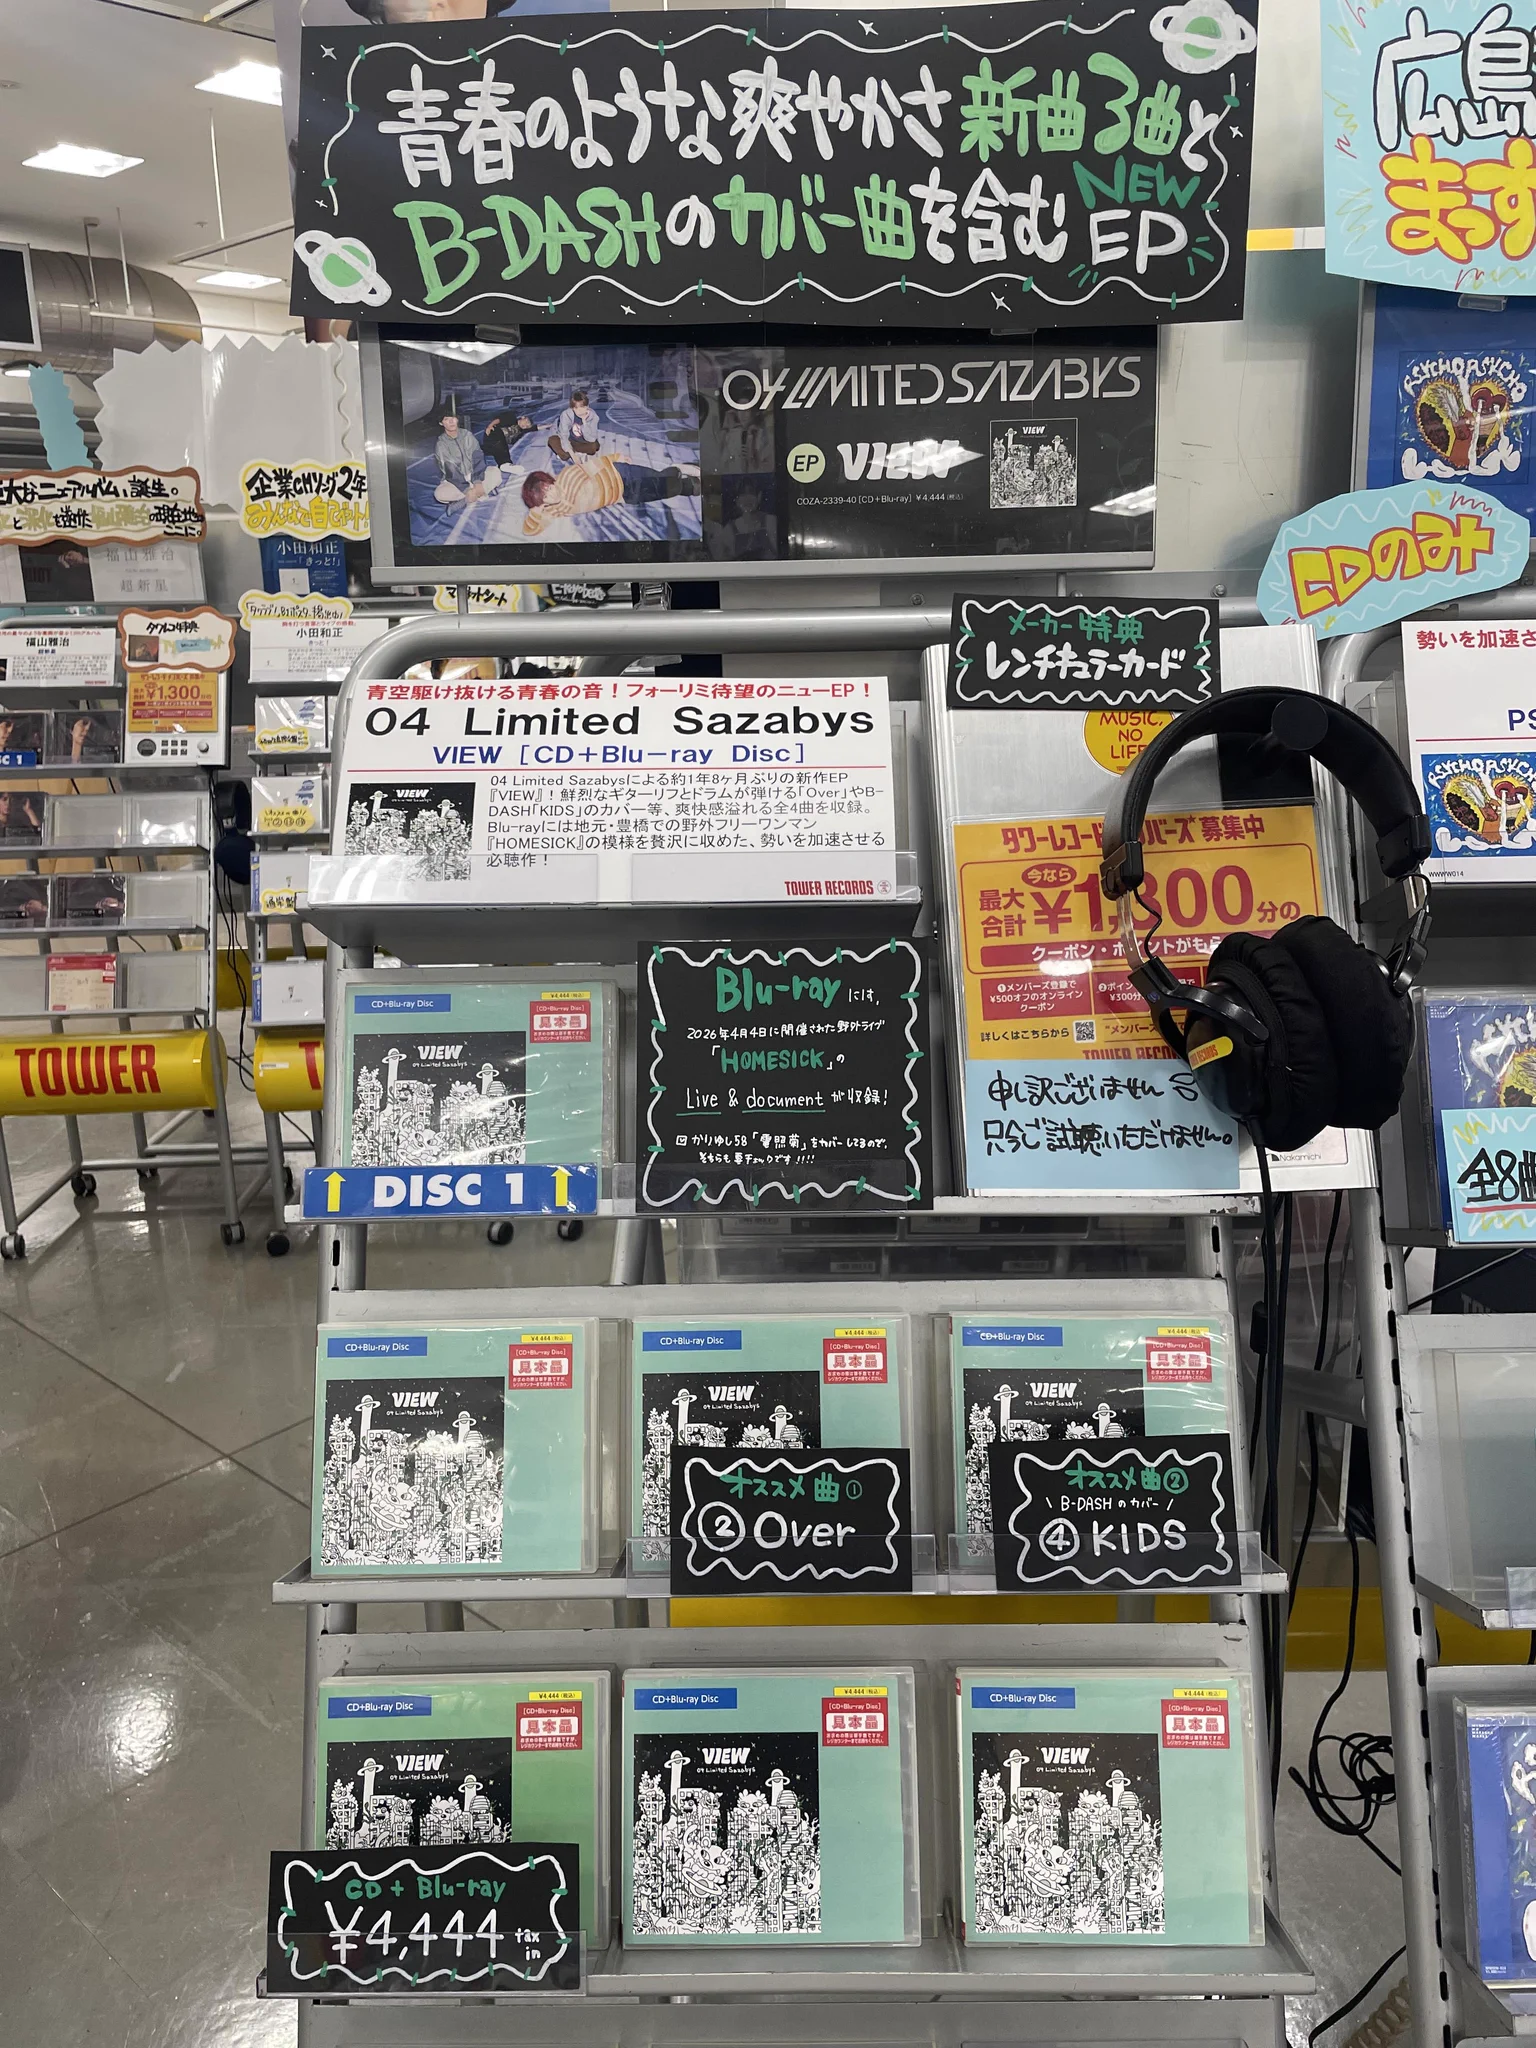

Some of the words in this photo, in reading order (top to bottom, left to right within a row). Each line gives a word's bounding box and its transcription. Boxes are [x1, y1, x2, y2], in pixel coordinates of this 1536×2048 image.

[1373, 3, 1536, 152] 広島
[378, 53, 1219, 187] 青春のような爽やかさ新曲3曲と
[1073, 156, 1200, 209] NEW
[393, 167, 1068, 303] B-DASHのカバー曲を含む
[1090, 210, 1188, 273] EP
[946, 356, 1141, 403] SAZABYS
[1022, 426, 1045, 435] VIEW
[793, 455, 819, 471] EP
[277, 541, 339, 555] 小田和正
[1288, 512, 1494, 618] CDのみ
[296, 627, 343, 638] 小田和正
[1008, 609, 1144, 645] メーカー特典
[986, 640, 1187, 681] レンチキュラーカード
[365, 707, 430, 736] 04
[464, 706, 640, 736] Limited
[673, 705, 874, 737] Sazabys
[1099, 711, 1163, 726] MUSIC,
[1118, 729, 1142, 742] NO
[433, 745, 502, 764] VIEW
[732, 743, 804, 763] Disc]
[491, 775, 507, 786] 04
[513, 775, 564, 786] Limited
[395, 788, 429, 798] VIEW
[1201, 814, 1265, 842] 募集中
[1027, 865, 1072, 883] 今なら
[785, 880, 822, 895] TOWER
[825, 880, 874, 895] RECORDS
[980, 888, 1025, 911] 最大
[1256, 901, 1300, 923] 分の
[981, 914, 1026, 938] 合計
[716, 966, 841, 1012] Blu-ray
[417, 999, 434, 1008] Disc
[1020, 1004, 1055, 1012] クーポン
[687, 1020, 885, 1040] 2026年4月4日に開催された野外ライブ
[981, 1027, 1070, 1041] 詳しくはこちらから
[418, 1045, 463, 1059] VIEW
[712, 1045, 845, 1074] 「HOMESICK」の
[14, 1044, 161, 1097] TOWER
[686, 1088, 718, 1109] Live
[728, 1088, 738, 1107] &
[746, 1088, 824, 1109] document
[988, 1069, 1164, 1111] 申し訳ございません
[983, 1117, 1233, 1157] 只今ご試聴いただけません。
[373, 1174, 481, 1208] DISC
[505, 1172, 523, 1204] 1
[392, 1342, 409, 1351] Disc
[660, 1337, 704, 1346] CD+Blu-ray
[706, 1336, 724, 1345] Disc
[833, 1354, 877, 1368] 見本品
[708, 1386, 754, 1401] VIEW
[1030, 1382, 1077, 1398] VIEW
[391, 1392, 439, 1408] VIEW
[1060, 1496, 1158, 1511] B-DASHのカバー
[754, 1511, 855, 1549] Over
[1093, 1519, 1187, 1556] KIDS
[652, 1694, 698, 1705] CD+Blu-ray
[700, 1694, 719, 1703] Disc
[989, 1694, 1036, 1704] CD+Blu-ray
[1038, 1693, 1057, 1702] Disc
[346, 1702, 393, 1713] CD+Blu-ray
[396, 1702, 413, 1711] Disc
[526, 1719, 572, 1734] 見本品
[832, 1715, 878, 1729] 見本品
[1172, 1717, 1219, 1731] 見本品
[395, 1754, 444, 1771] VIEW
[702, 1748, 750, 1764] VIEW
[1040, 1747, 1090, 1764] VIEW
[345, 1880, 381, 1901] CD
[390, 1881, 405, 1896] +
[417, 1876, 506, 1902] Blu-ray
[324, 1901, 504, 1964] ¥4,444
[514, 1928, 540, 1943] tax
[525, 1947, 541, 1960] in
